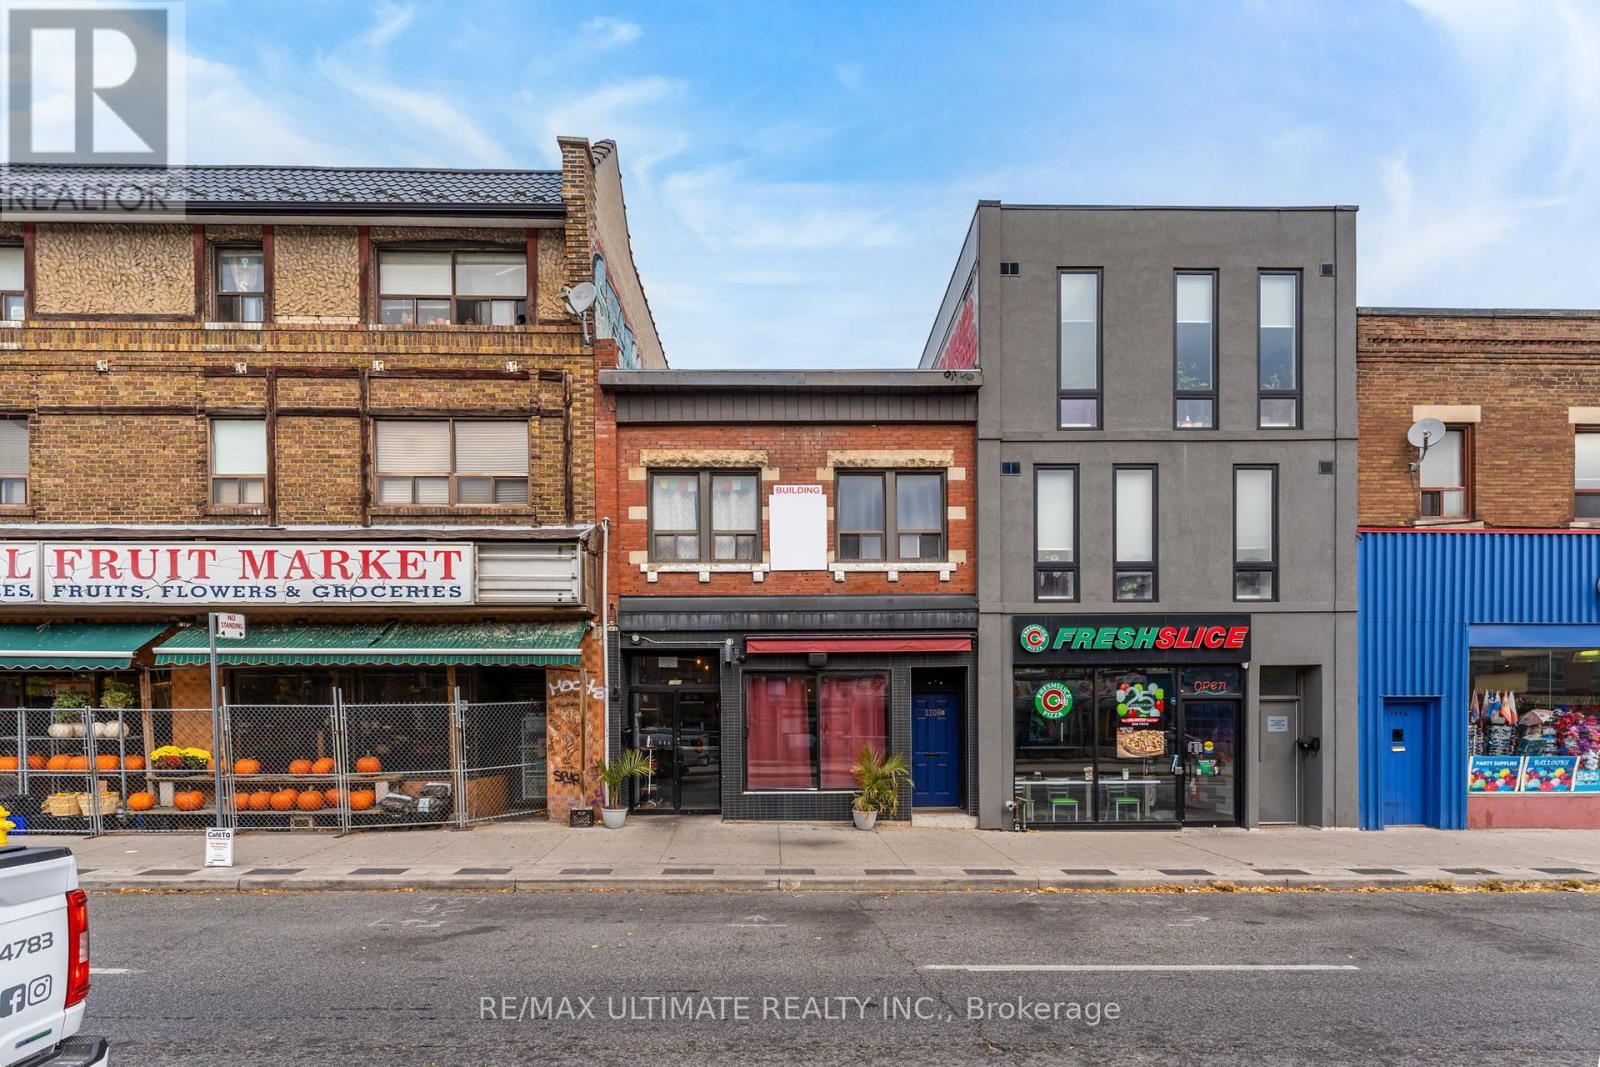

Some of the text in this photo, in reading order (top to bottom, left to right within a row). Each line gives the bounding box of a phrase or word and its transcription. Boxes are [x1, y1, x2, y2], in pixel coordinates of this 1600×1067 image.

[776, 486, 820, 494] BUILDING
[6, 549, 31, 580] L
[53, 549, 462, 580] FRUIT MARKET
[0, 584, 34, 598] ES,
[53, 585, 462, 599] FRUITS, FLOWERS & GROCERIES
[221, 621, 244, 629] STANDING
[1053, 626, 1249, 649] FRESHSLICE
[1036, 682, 1072, 699] FRESHSLICE
[1126, 686, 1156, 714] 25
[1043, 711, 1064, 719] PIZZA
[0, 931, 53, 961] 4783
